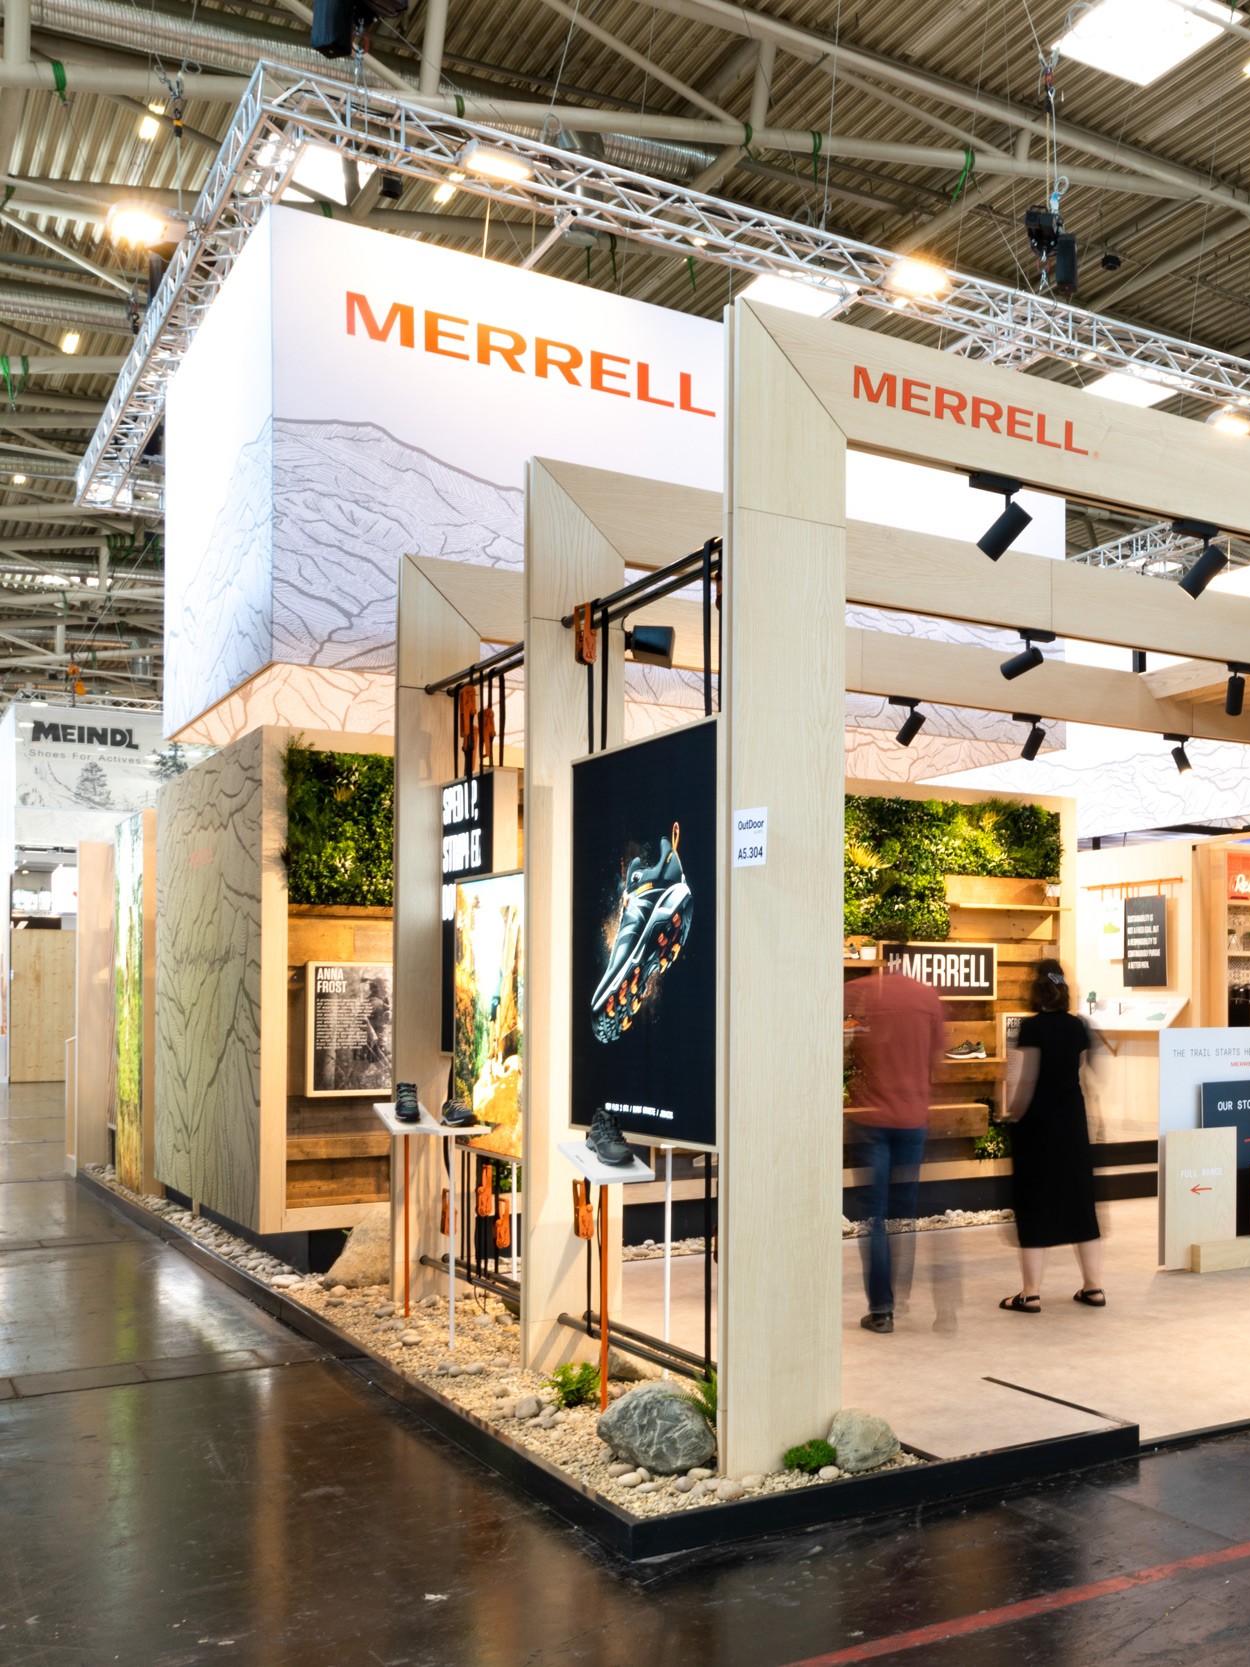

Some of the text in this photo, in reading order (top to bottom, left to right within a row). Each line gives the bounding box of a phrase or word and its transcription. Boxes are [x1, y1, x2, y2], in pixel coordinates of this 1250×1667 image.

[346, 291, 716, 418] MERRELL
[853, 365, 1089, 456] MERRELL
[31, 720, 139, 750] MEINDL
[29, 748, 141, 764] Shoes For Actives
[738, 819, 765, 831] OutDoor
[738, 846, 763, 860] A5.304
[316, 967, 345, 981] ANNA
[316, 981, 348, 994] FROST
[1172, 1048, 1186, 1058] THE
[1190, 1048, 1211, 1057] TRAIL
[1215, 1047, 1241, 1057] STARTS
[1217, 1100, 1233, 1111] OUR
[1180, 1166, 1224, 1179] FULL RANGE
